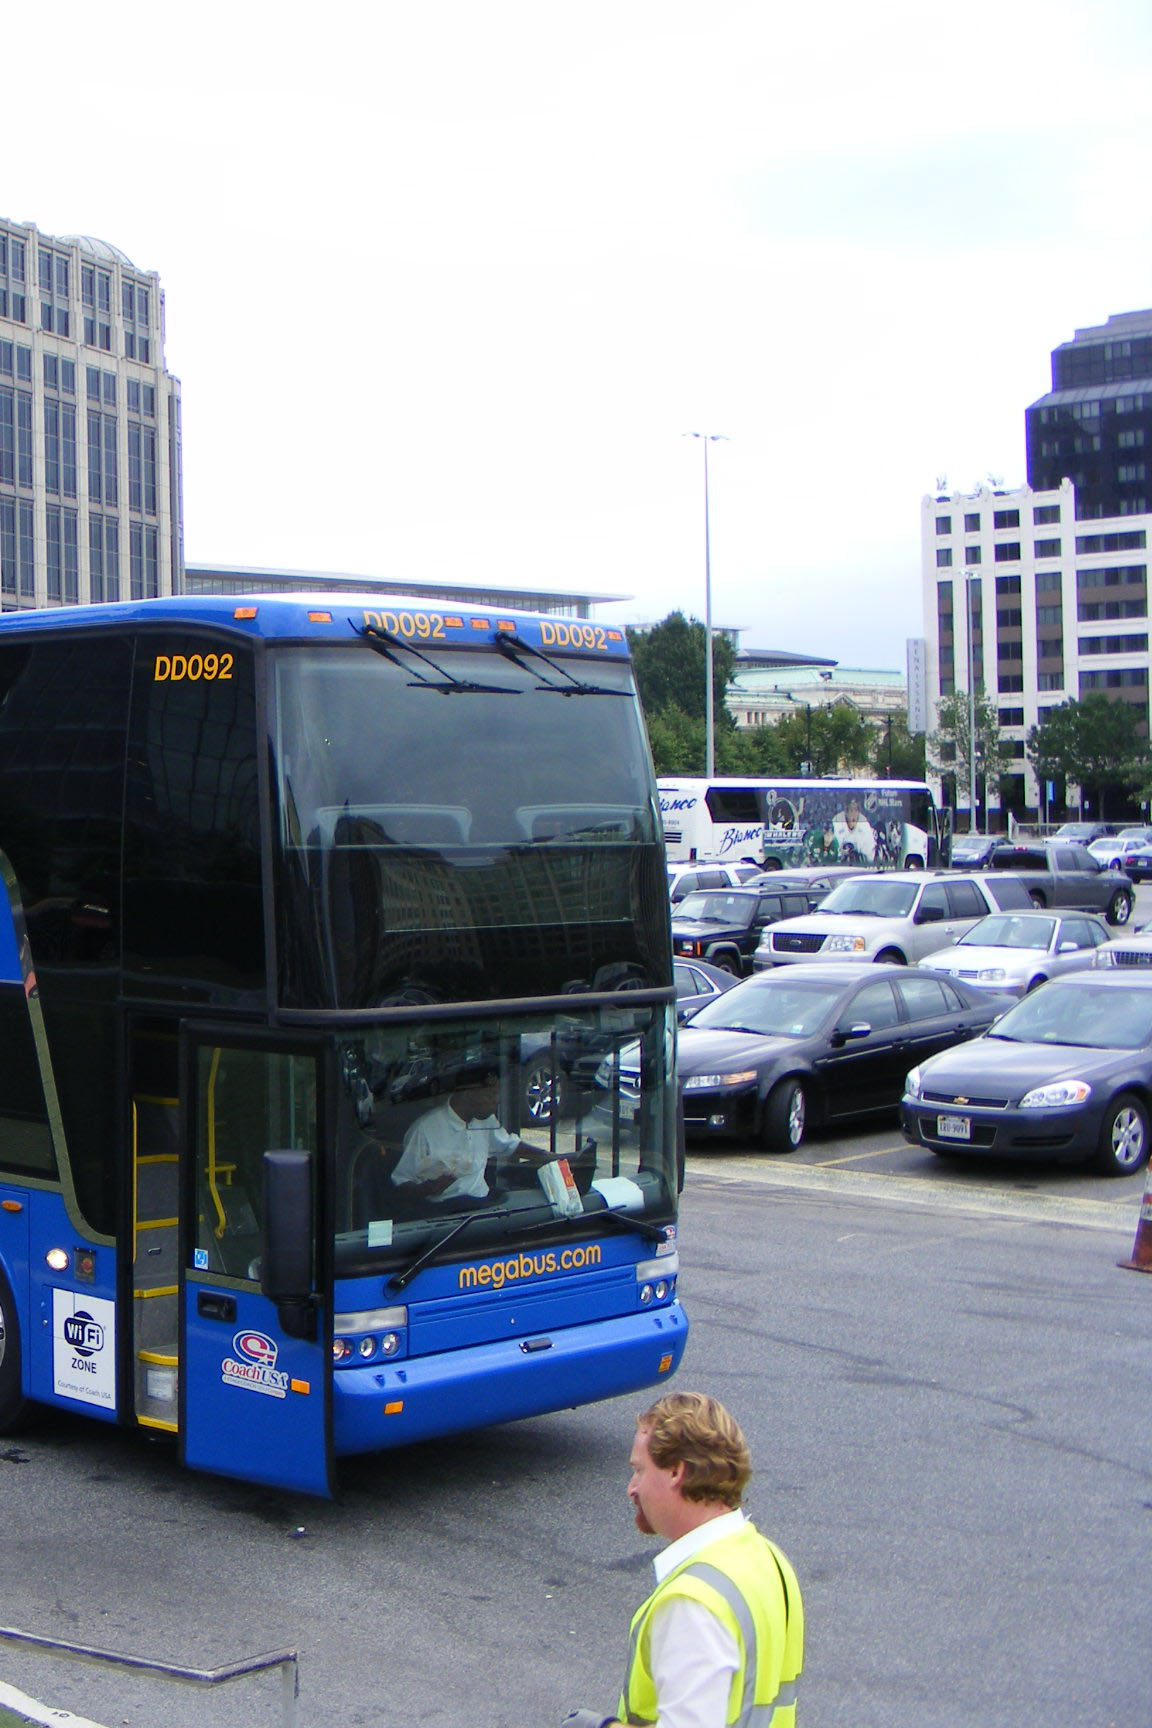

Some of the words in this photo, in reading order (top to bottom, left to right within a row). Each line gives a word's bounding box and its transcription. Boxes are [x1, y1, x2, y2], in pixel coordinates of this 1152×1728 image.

[363, 611, 446, 638] DD092
[539, 621, 608, 650] DD092
[154, 653, 234, 681] DD092
[657, 797, 697, 813] ianco
[458, 1244, 601, 1289] megabus.com
[71, 1357, 97, 1374] ZONE
[223, 1360, 260, 1381] Coach
[260, 1367, 287, 1388] USA
